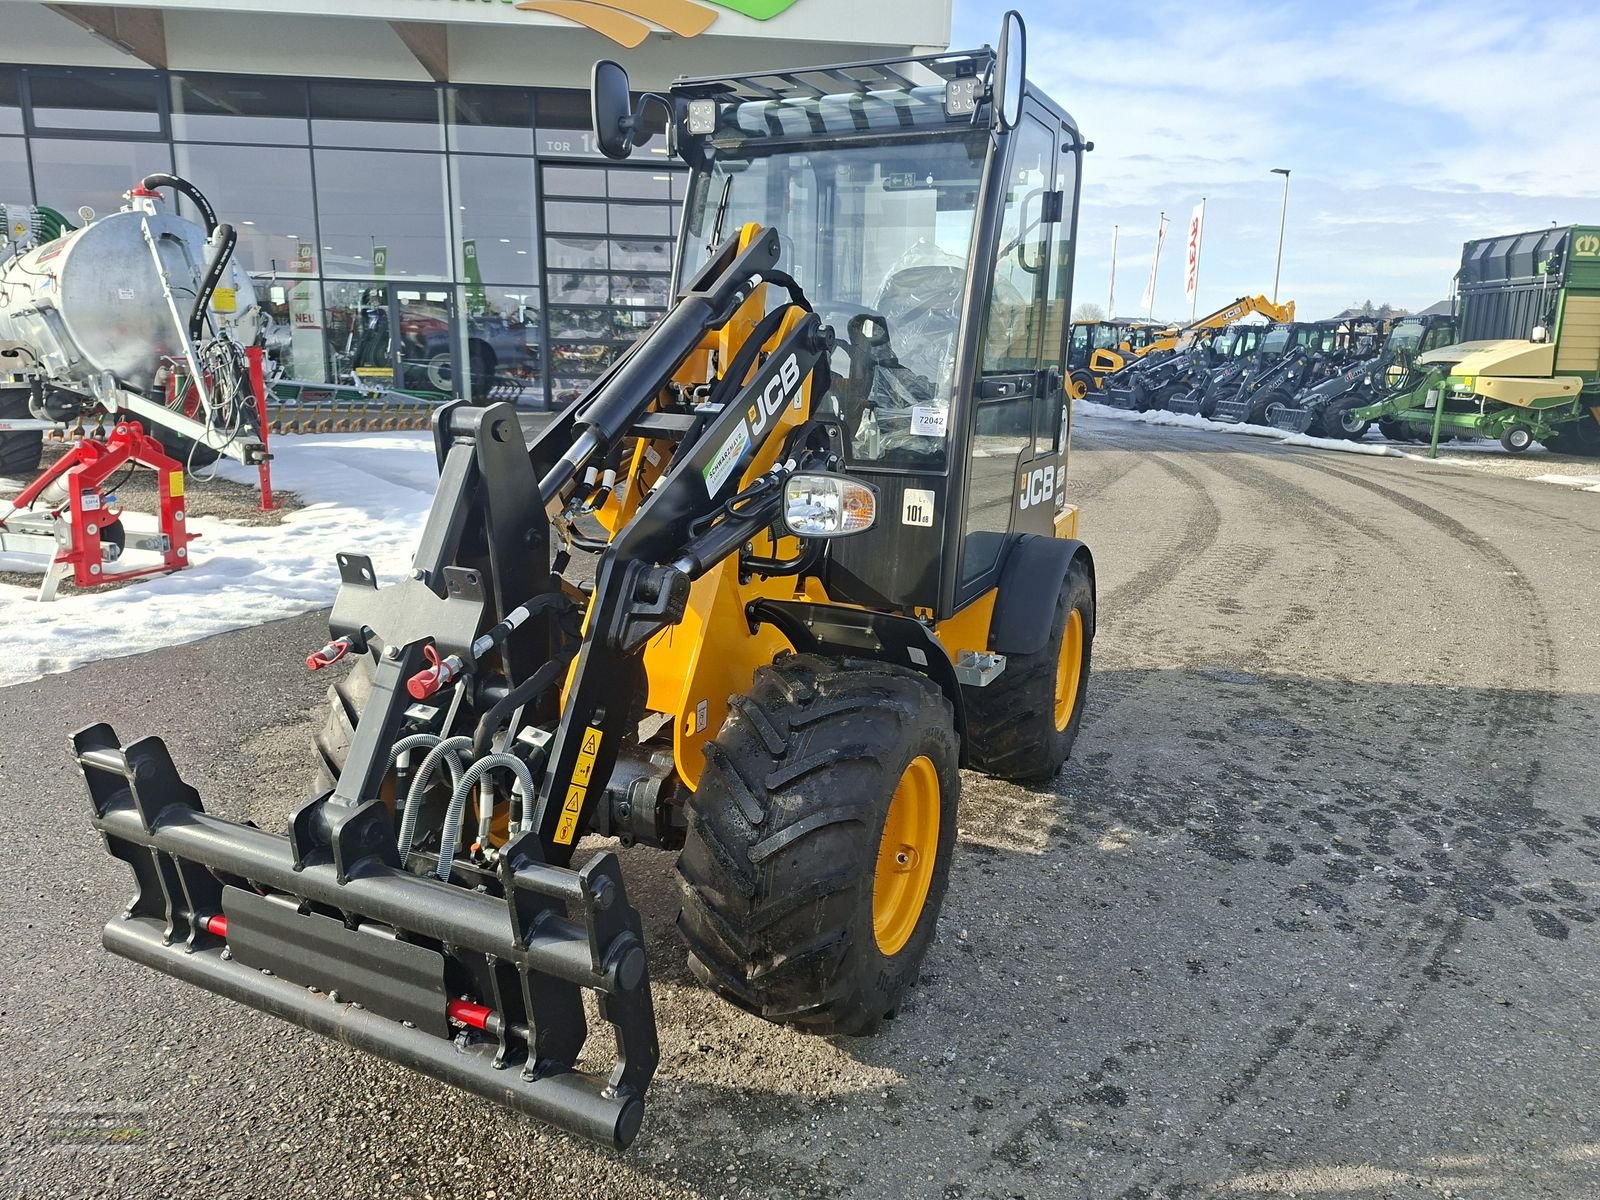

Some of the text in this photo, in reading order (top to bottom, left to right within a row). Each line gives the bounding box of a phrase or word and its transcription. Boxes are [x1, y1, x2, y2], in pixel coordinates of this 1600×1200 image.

[546, 141, 571, 151] TOR
[295, 312, 315, 323] NEU
[1223, 307, 1242, 321] JCB
[751, 352, 800, 436] JCB
[919, 415, 944, 425] 72042
[708, 432, 743, 479] SCHWARZMAYR
[1019, 465, 1055, 511] JCB
[906, 504, 923, 523] 101
